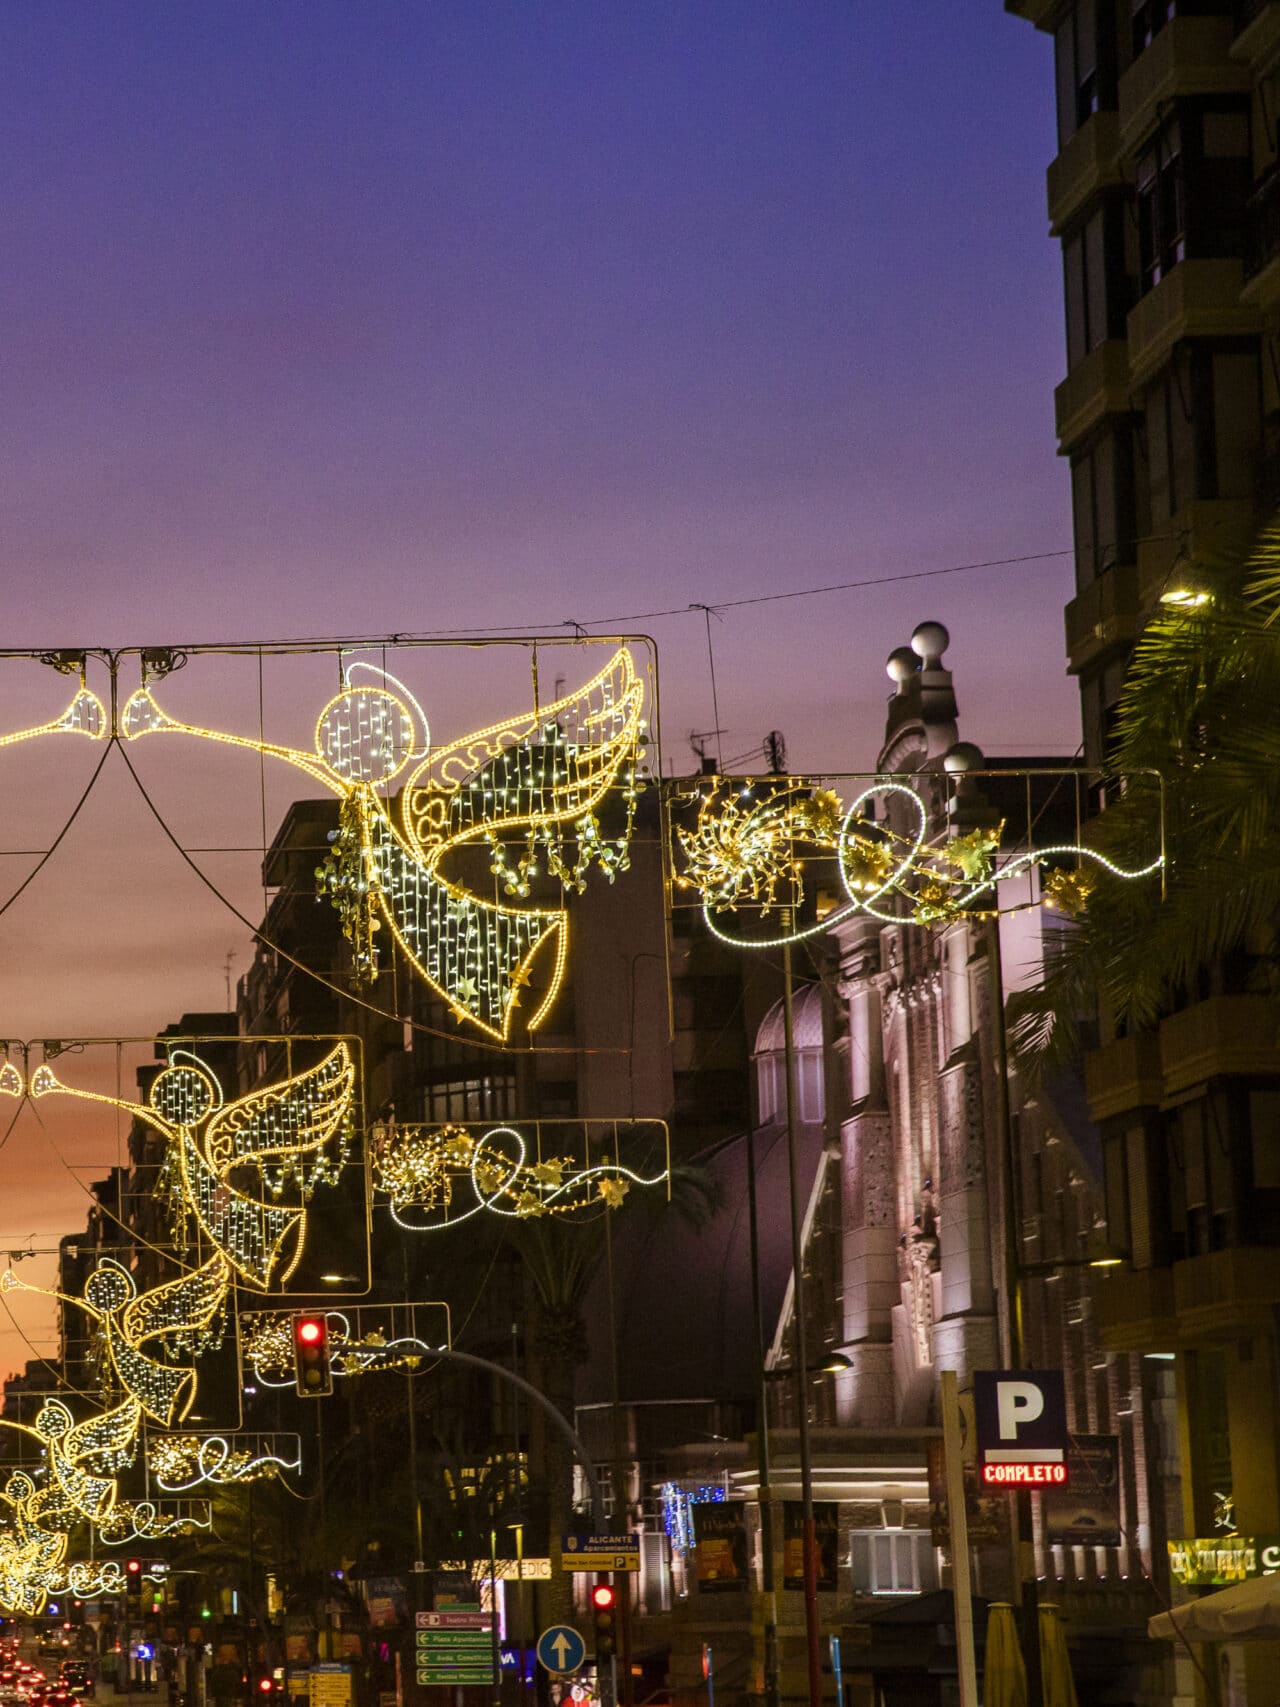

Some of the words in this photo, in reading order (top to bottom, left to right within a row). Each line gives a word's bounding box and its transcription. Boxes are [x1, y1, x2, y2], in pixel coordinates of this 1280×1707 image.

[997, 1381, 1044, 1439] P
[984, 1465, 1065, 1481] COMPLETO
[589, 1535, 632, 1544] ALICANTE
[615, 1557, 624, 1568] P
